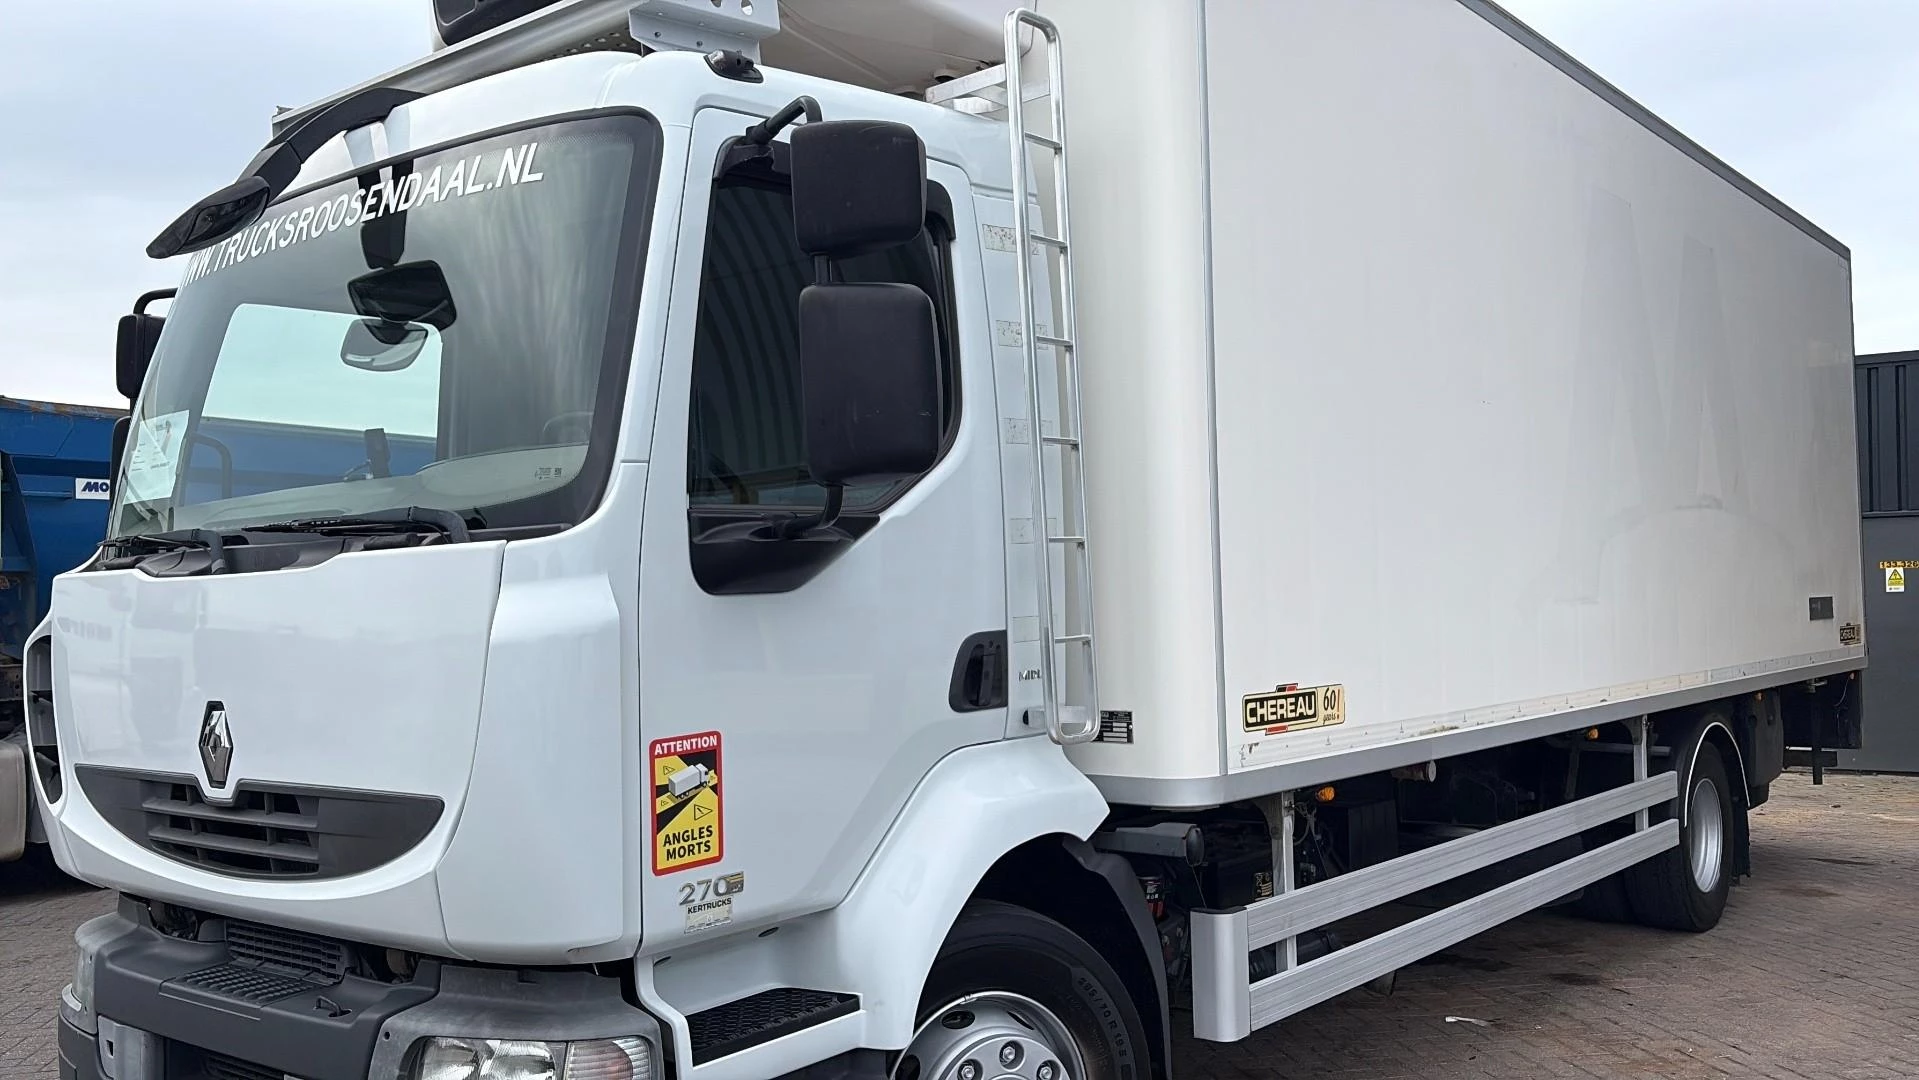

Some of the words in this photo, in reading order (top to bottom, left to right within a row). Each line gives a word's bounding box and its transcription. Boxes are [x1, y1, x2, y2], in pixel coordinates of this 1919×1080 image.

[1246, 694, 1315, 724] CHEREAU
[654, 735, 718, 755] ATTENTION
[663, 825, 713, 847] ANGLES
[666, 840, 711, 861] MORTS
[679, 877, 728, 906] 270
[687, 897, 732, 915] KERTRUCKS
